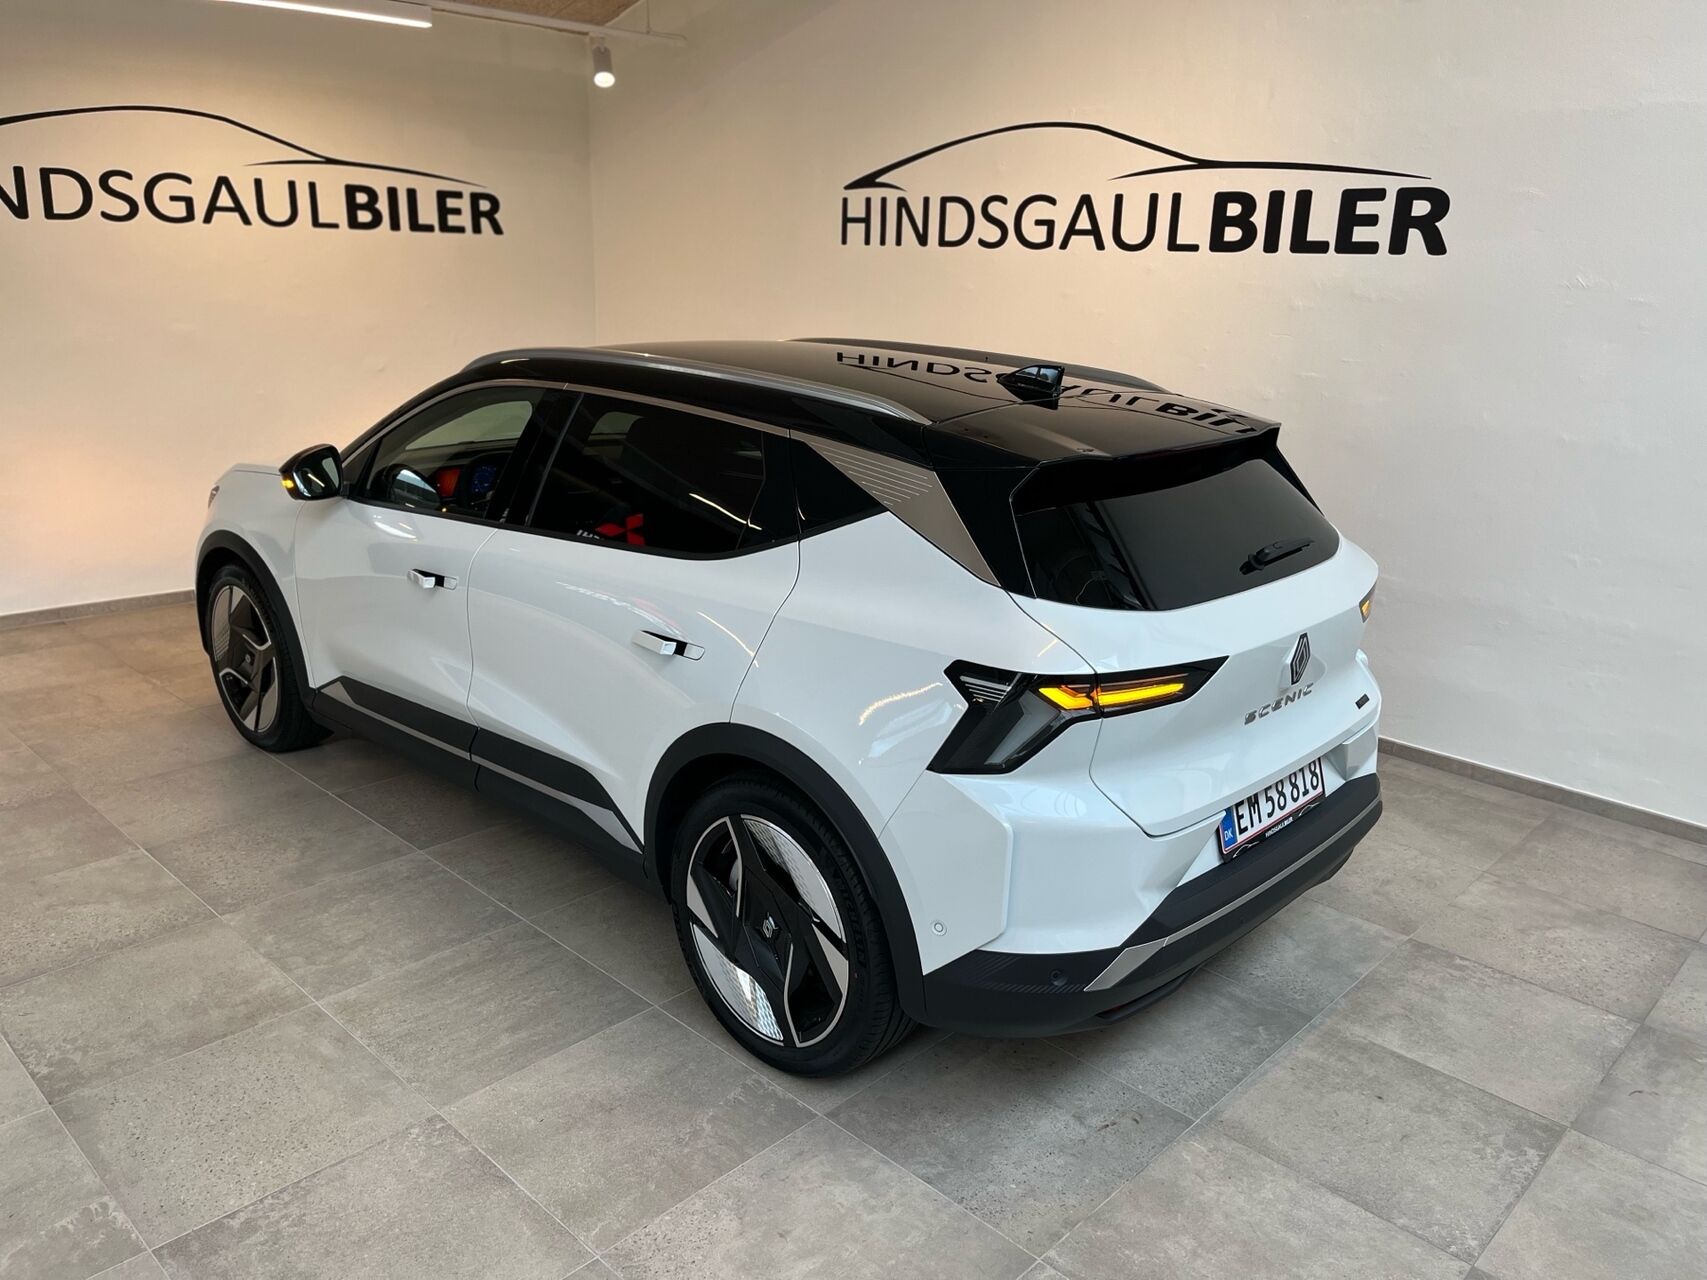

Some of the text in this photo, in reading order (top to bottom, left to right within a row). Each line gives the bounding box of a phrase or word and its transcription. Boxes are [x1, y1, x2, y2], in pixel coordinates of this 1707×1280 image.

[841, 187, 1451, 256] HINDSGAULBILER
[1244, 682, 1314, 725] SCENIC
[1224, 827, 1234, 841] DK
[1235, 791, 1262, 835] EM
